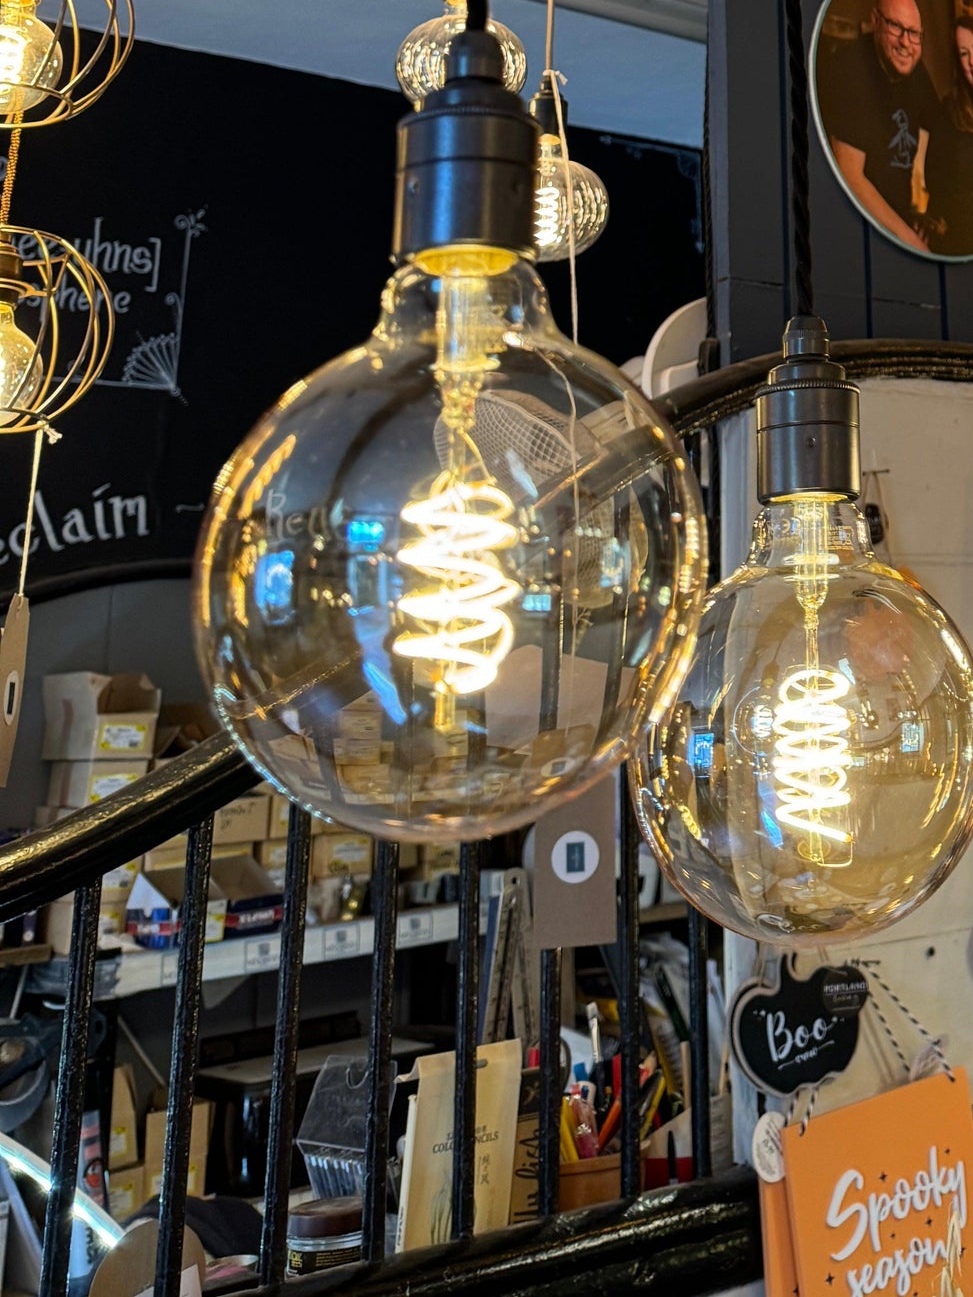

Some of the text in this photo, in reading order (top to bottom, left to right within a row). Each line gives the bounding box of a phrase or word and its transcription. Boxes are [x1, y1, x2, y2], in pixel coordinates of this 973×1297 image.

[766, 1010, 833, 1062] Boo
[826, 1145, 968, 1261] Spooky
[847, 1237, 951, 1297] season
